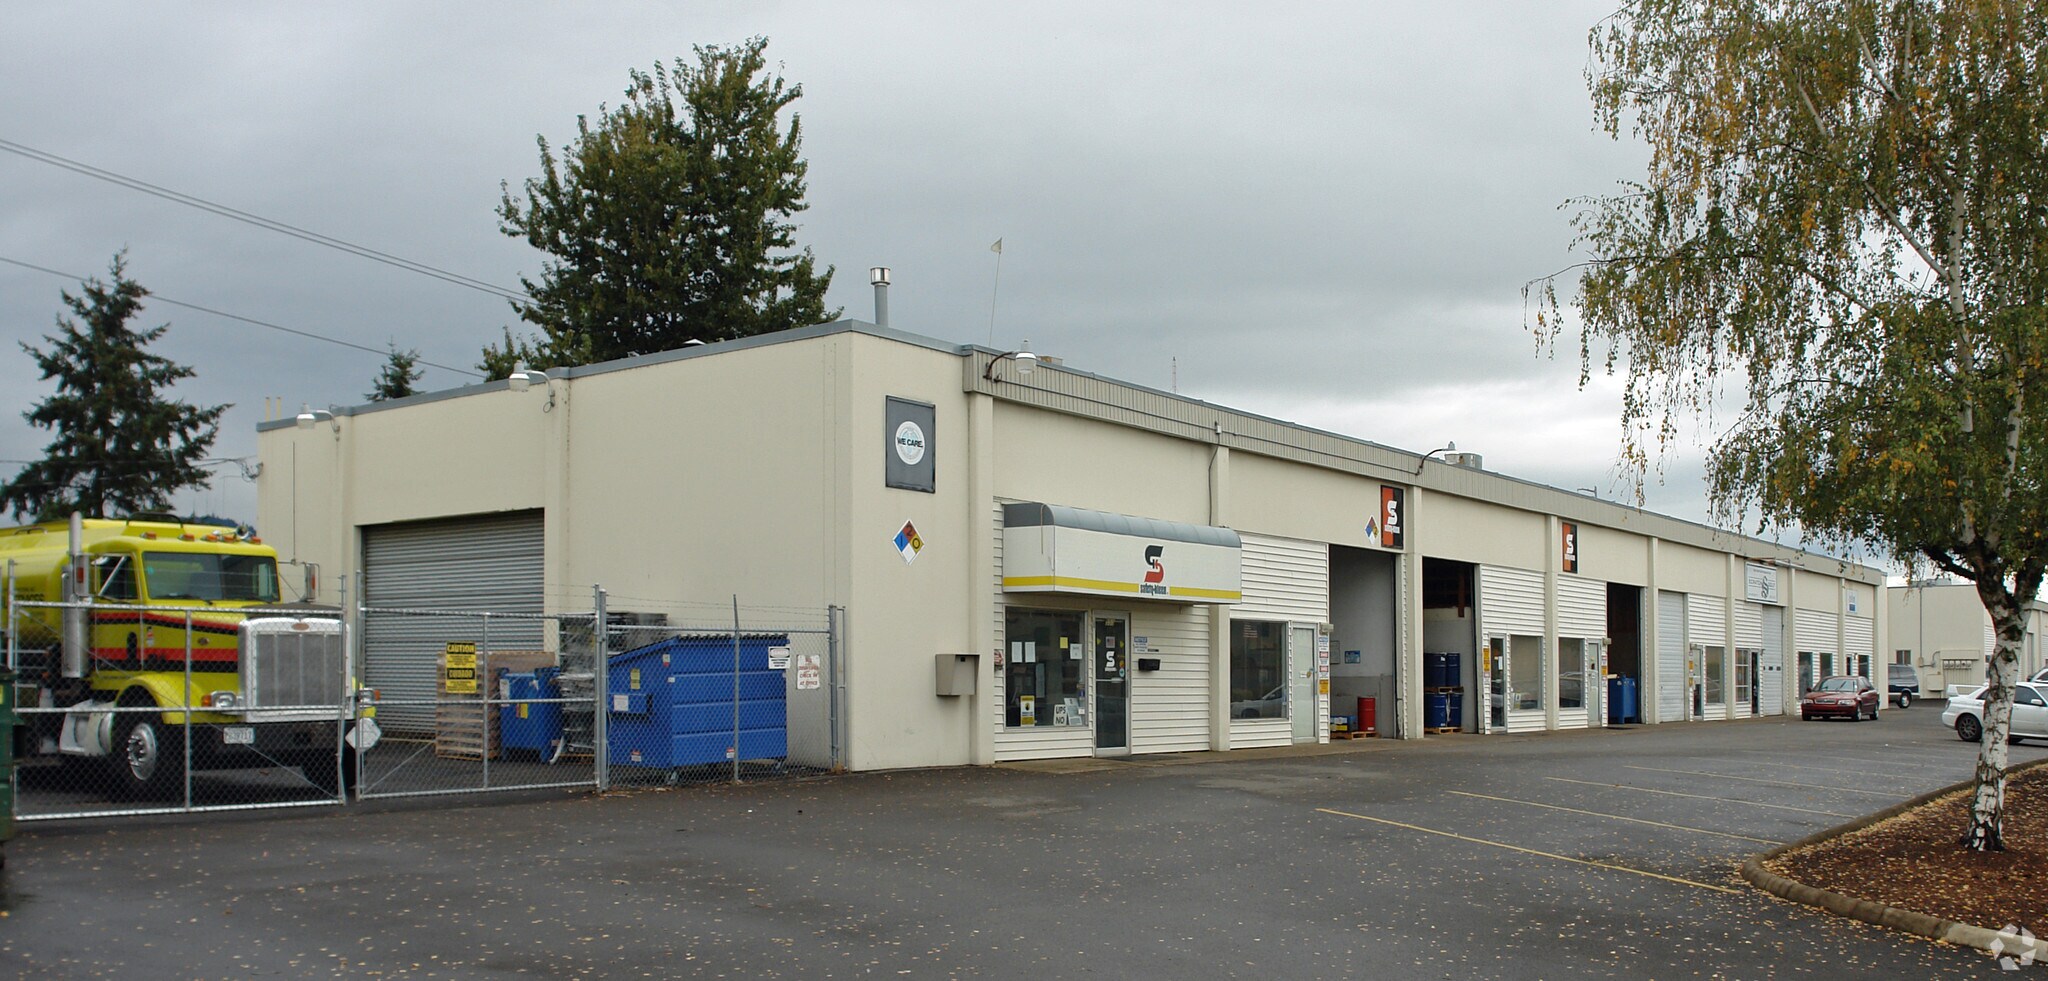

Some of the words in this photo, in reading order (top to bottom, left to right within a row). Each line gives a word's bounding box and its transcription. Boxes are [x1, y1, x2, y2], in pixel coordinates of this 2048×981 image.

[896, 437, 906, 446] WE
[906, 525, 913, 537] 2
[448, 644, 475, 653] CAUTION
[1055, 706, 1066, 714] UPS
[1055, 716, 1065, 724] NO
